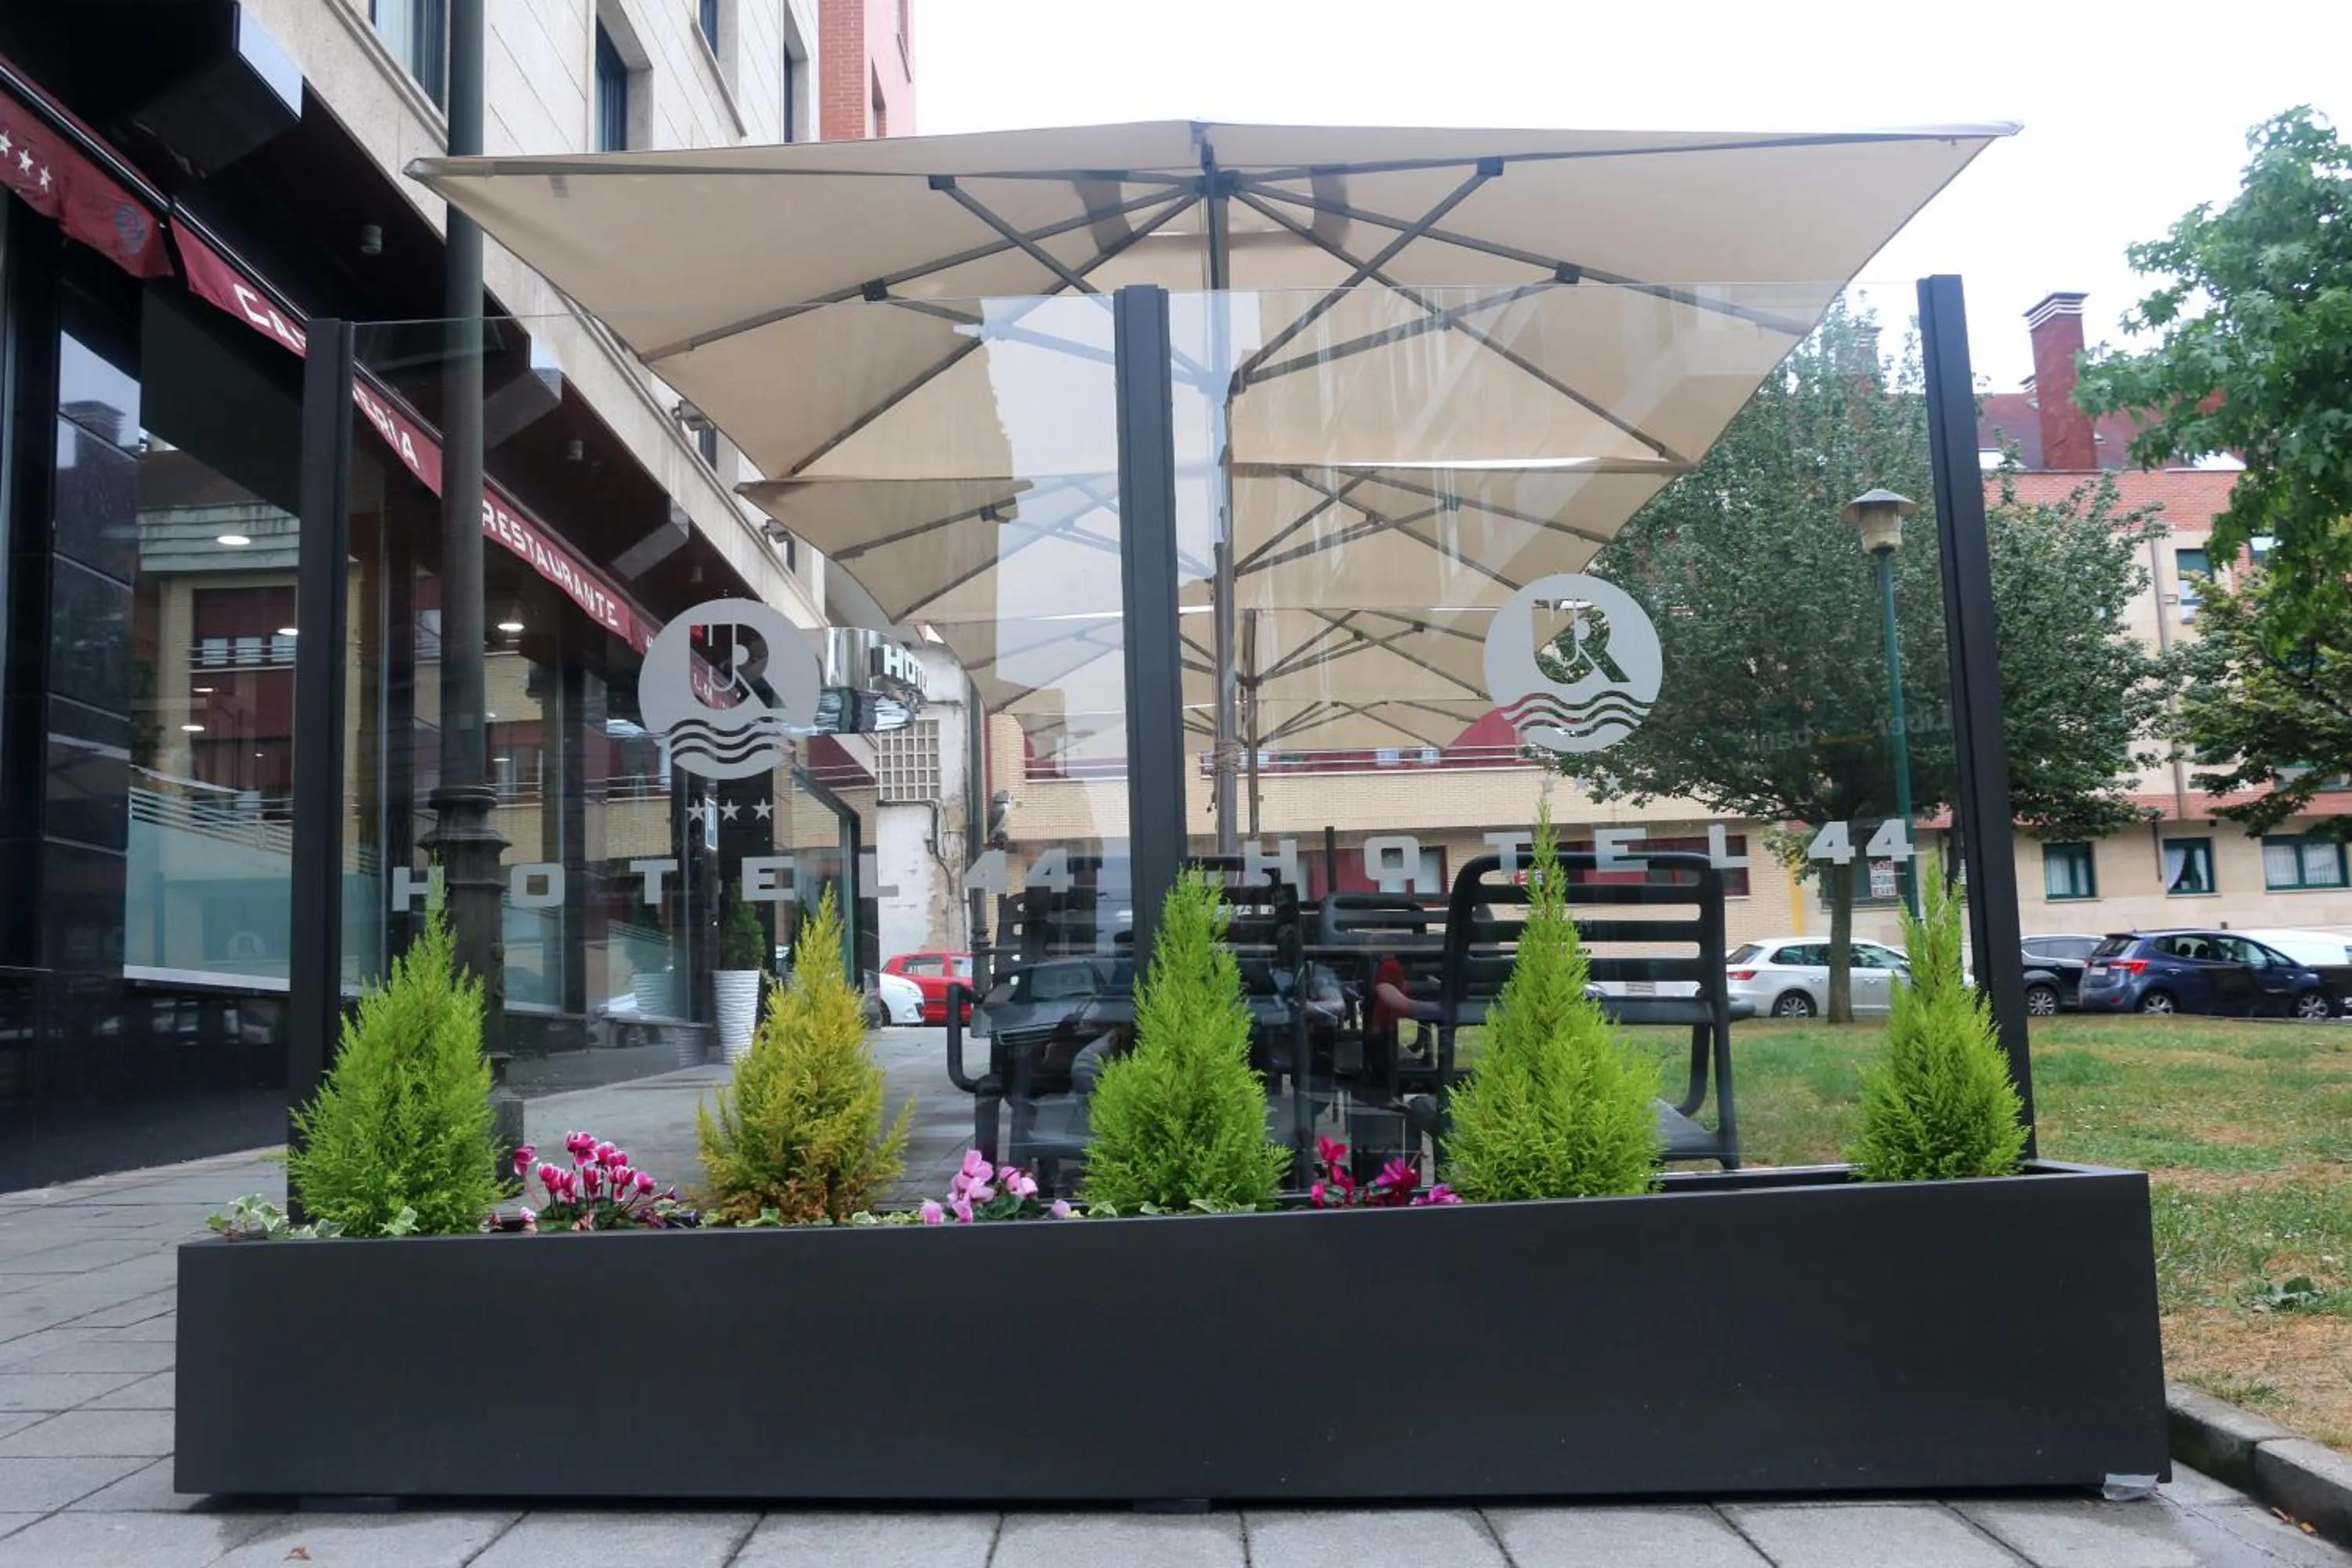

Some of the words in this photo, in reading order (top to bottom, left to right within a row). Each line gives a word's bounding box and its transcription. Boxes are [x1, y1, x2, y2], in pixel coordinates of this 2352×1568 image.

[481, 499, 619, 627] RESTAURANTE
[392, 851, 899, 912] HOTEL
[963, 848, 1075, 895] 44
[1243, 824, 1749, 887] HOTEL
[1807, 818, 1914, 865] 44
